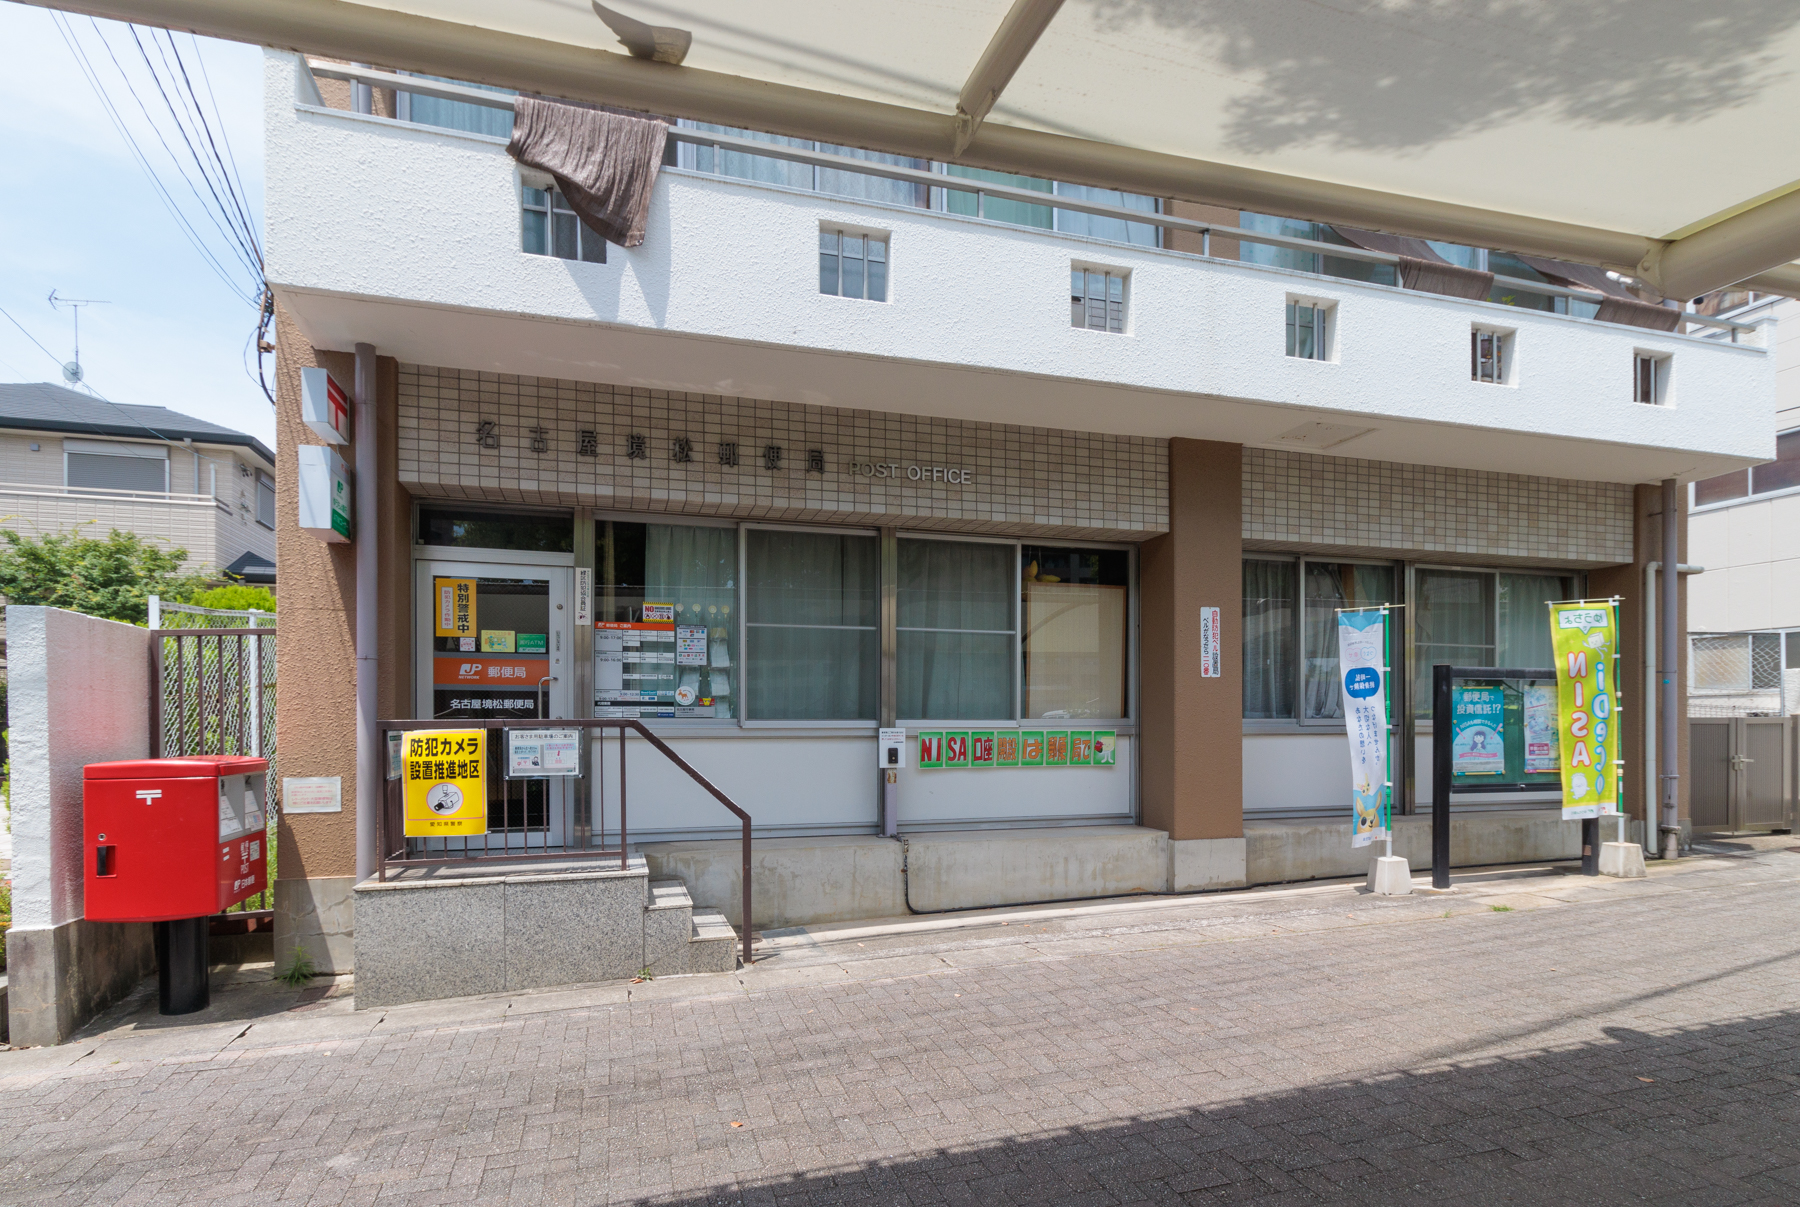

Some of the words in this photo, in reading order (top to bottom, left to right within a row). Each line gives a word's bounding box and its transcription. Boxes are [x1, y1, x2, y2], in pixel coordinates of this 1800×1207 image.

[475, 418, 826, 475] 名古屋境松郵便局
[848, 460, 898, 480] POST
[906, 464, 972, 485] OFFICE
[457, 583, 470, 634] 特別警戒中
[487, 666, 526, 678] 郵便局
[450, 698, 534, 709] 名古屋境松郵便局
[1463, 691, 1495, 702] 郵便局で
[410, 737, 479, 757] 防犯カメラ
[410, 759, 480, 780] 設置推進地区
